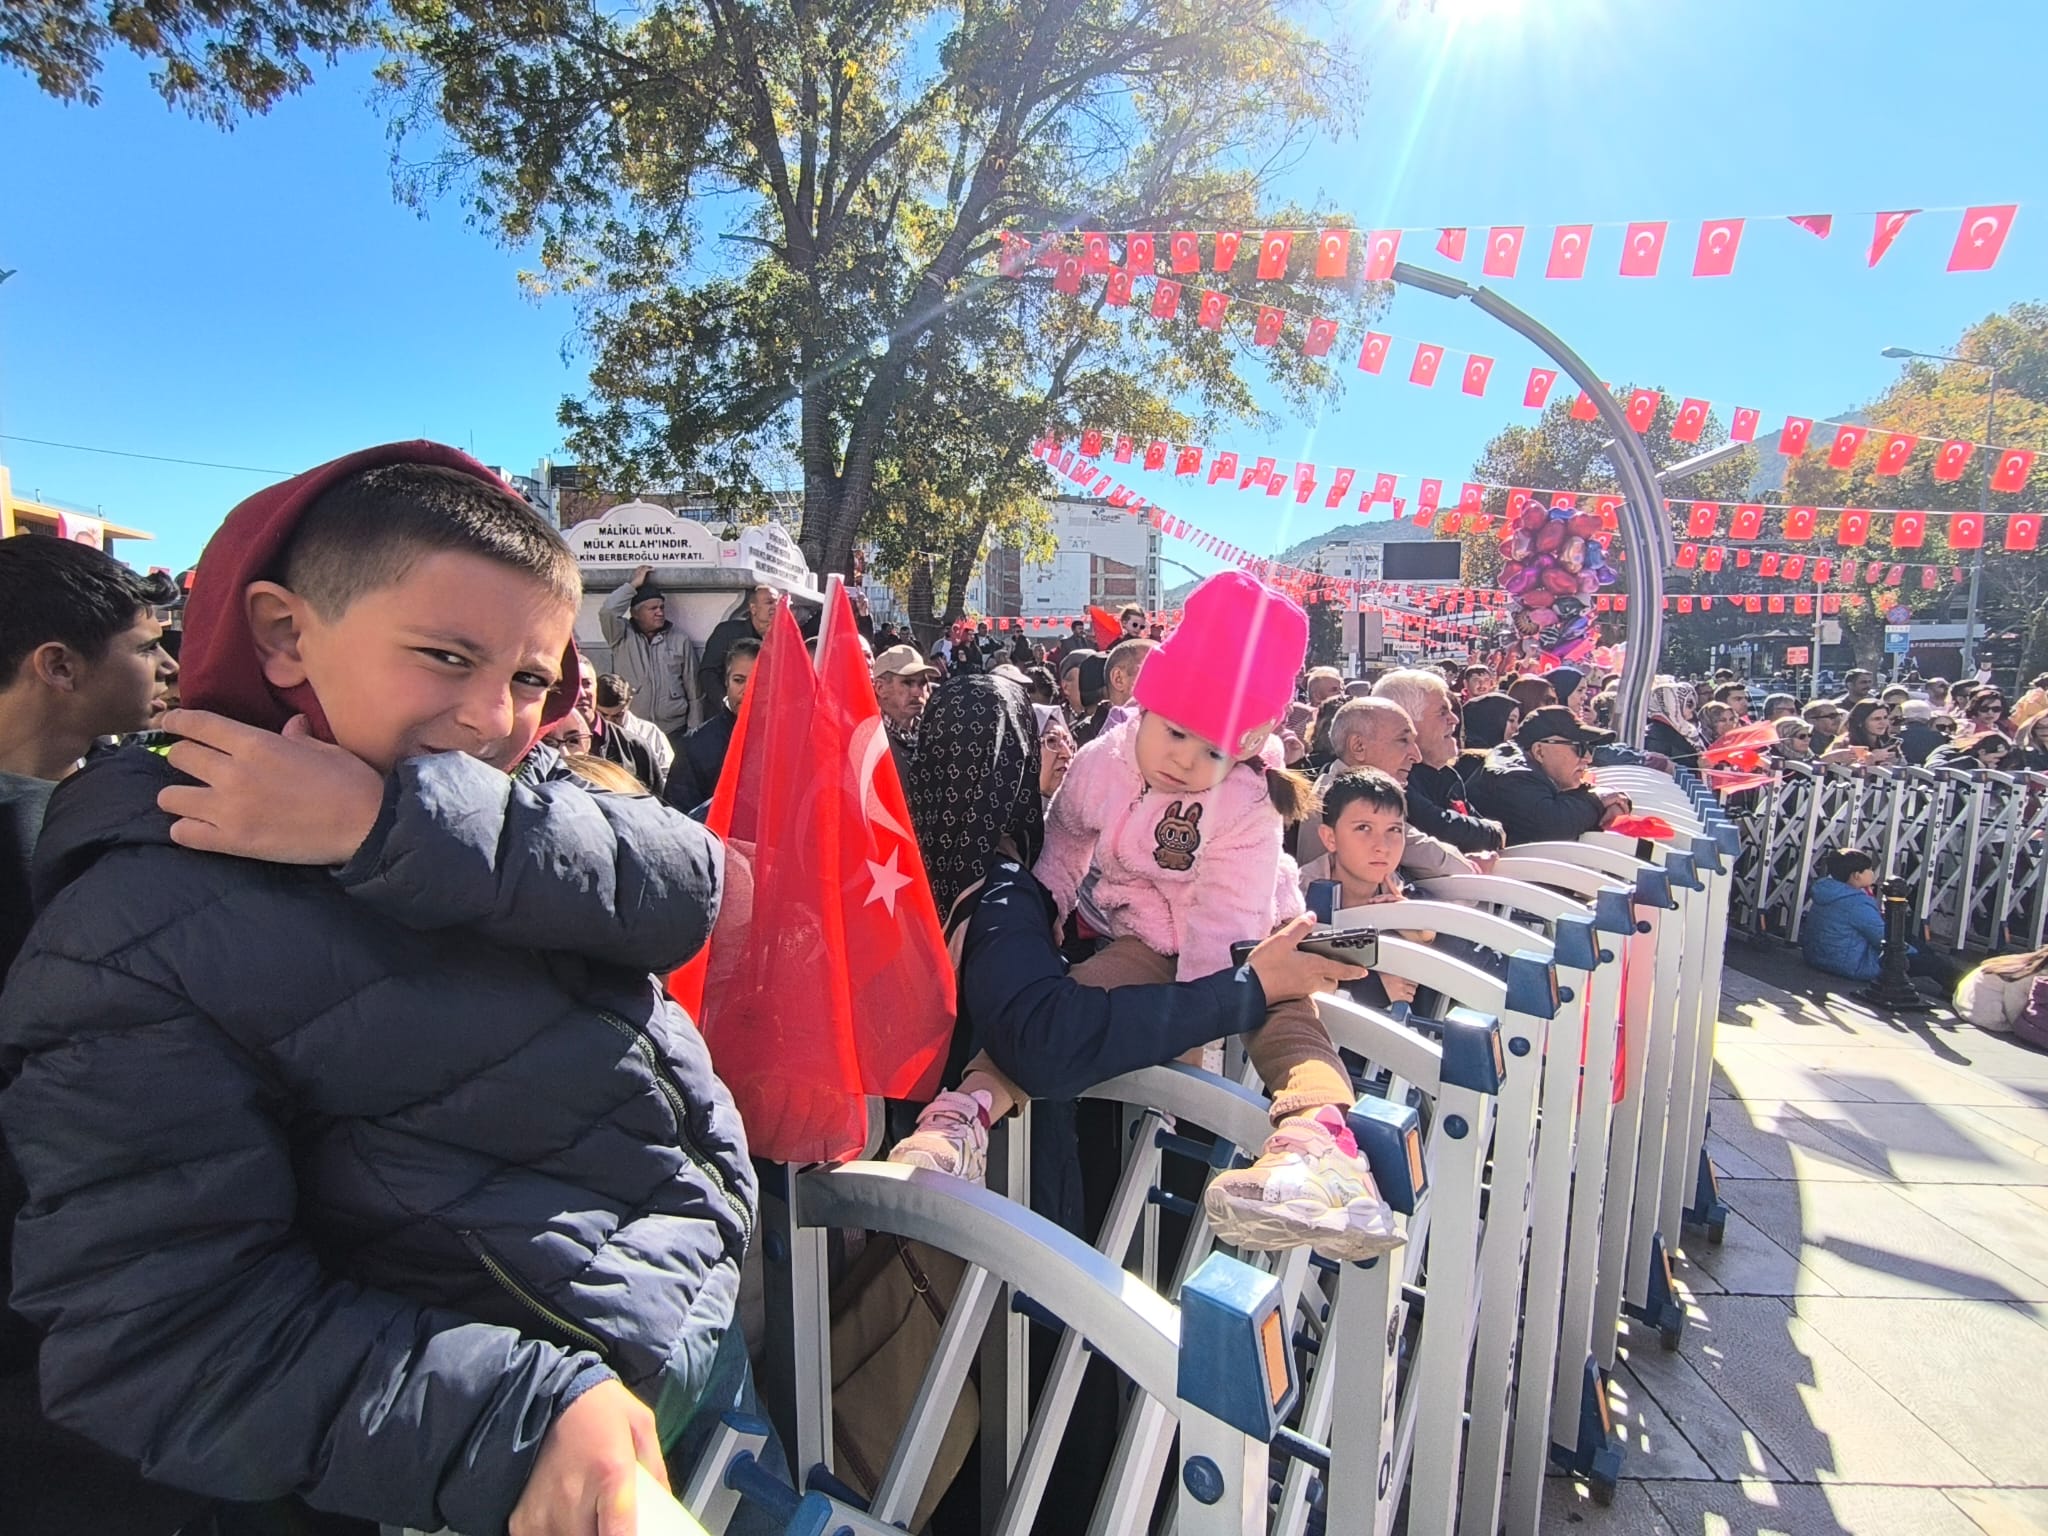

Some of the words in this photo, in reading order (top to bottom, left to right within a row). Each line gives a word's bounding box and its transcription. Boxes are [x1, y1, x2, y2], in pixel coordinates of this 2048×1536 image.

[645, 524, 676, 535] MÜLK.
[583, 538, 615, 549] MÜLK
[598, 551, 660, 561] BERBEROĞLU
[662, 552, 705, 560] HAYRATI.
